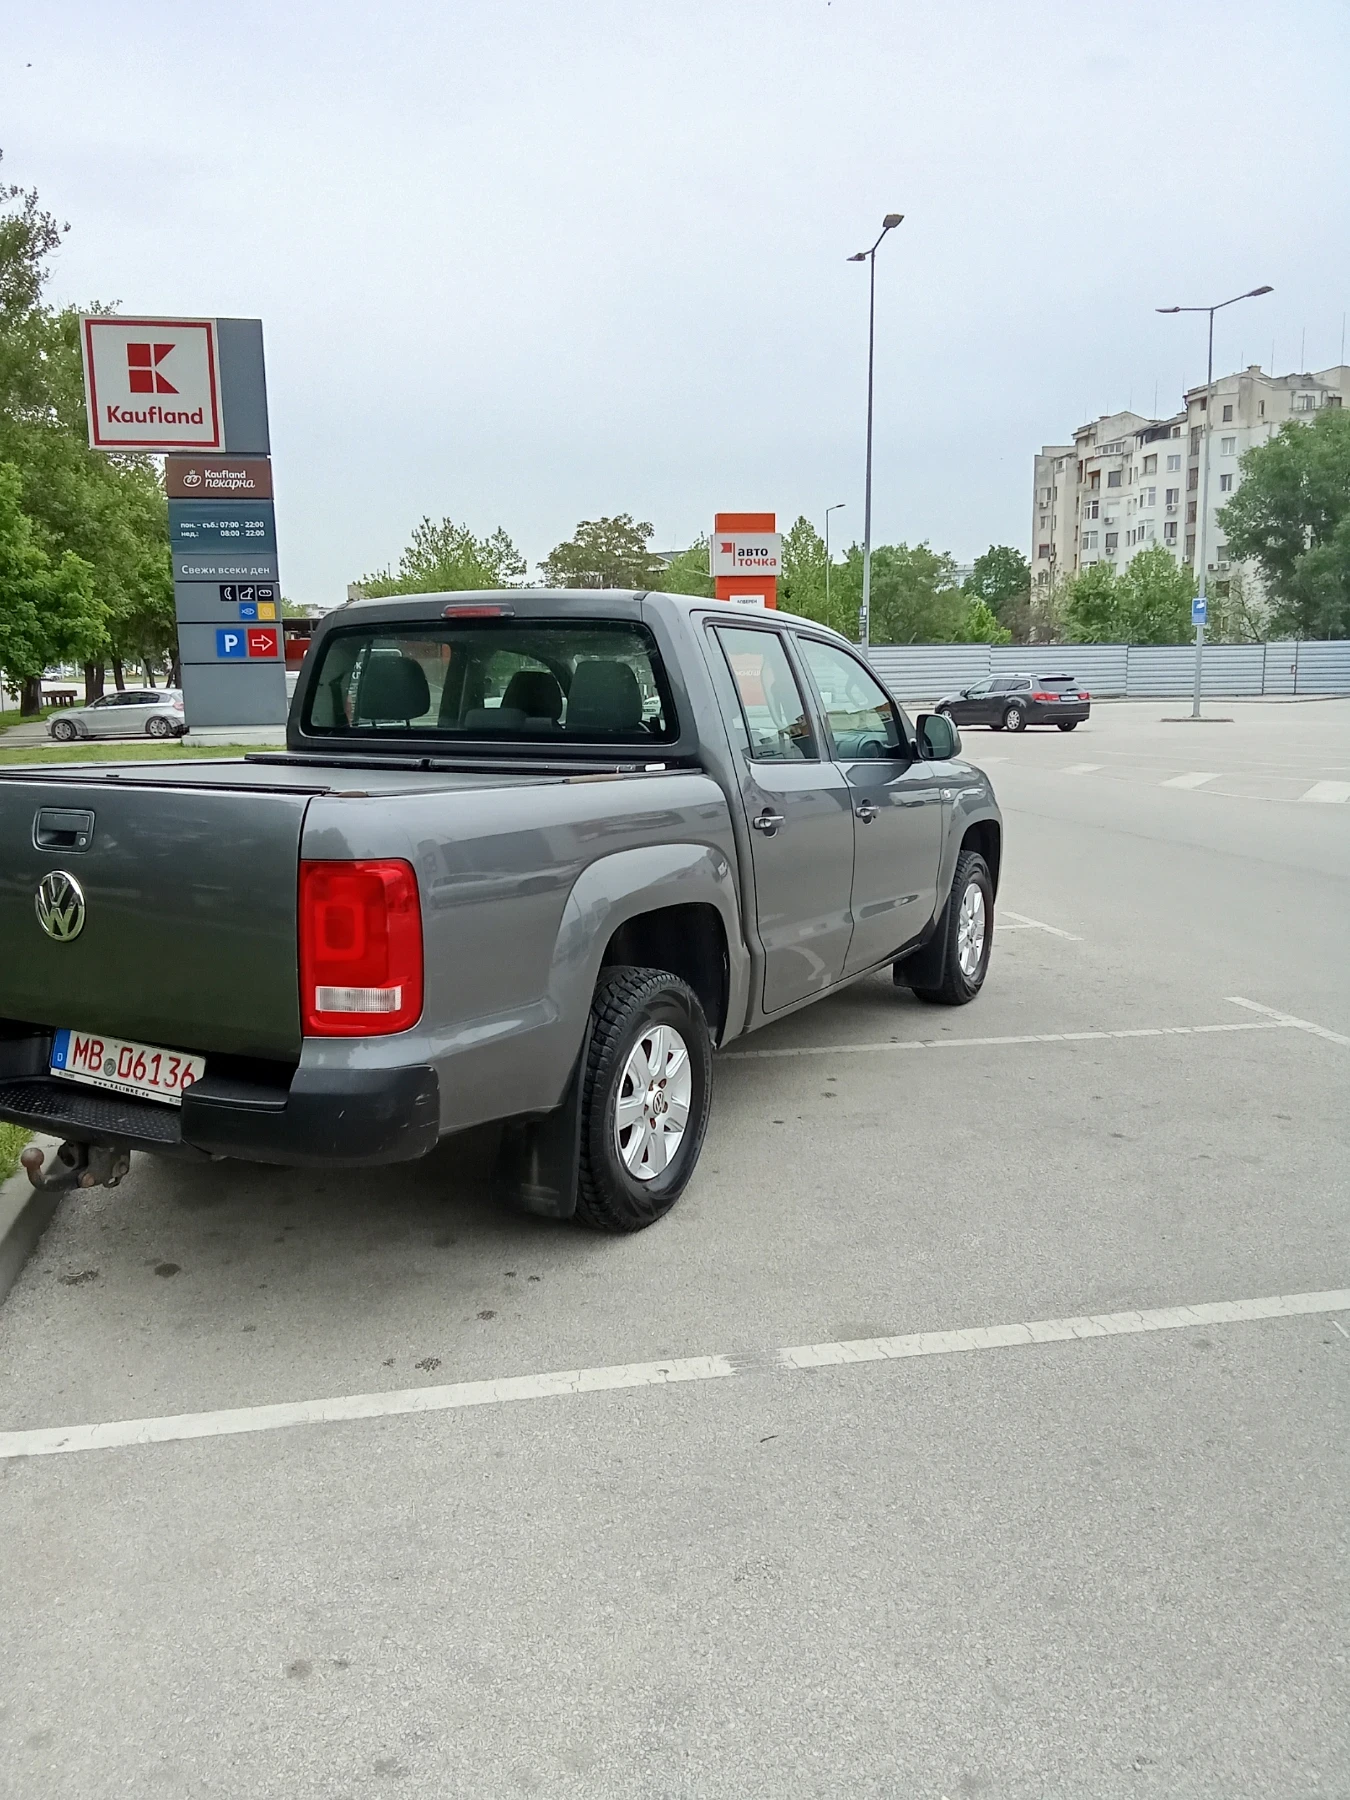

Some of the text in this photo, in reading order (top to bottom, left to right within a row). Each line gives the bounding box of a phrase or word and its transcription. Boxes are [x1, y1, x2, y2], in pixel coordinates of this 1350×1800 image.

[106, 405, 204, 425] Kaufland
[204, 469, 246, 479] Kaufland
[205, 478, 256, 490] пекарна
[220, 529, 240, 537] 08:00
[245, 529, 265, 537] 22:00
[737, 548, 769, 557] авто
[737, 558, 777, 567] точка
[181, 565, 270, 575] Свежи всеки ден
[224, 634, 238, 653] P
[72, 1035, 196, 1090] MB 06136
